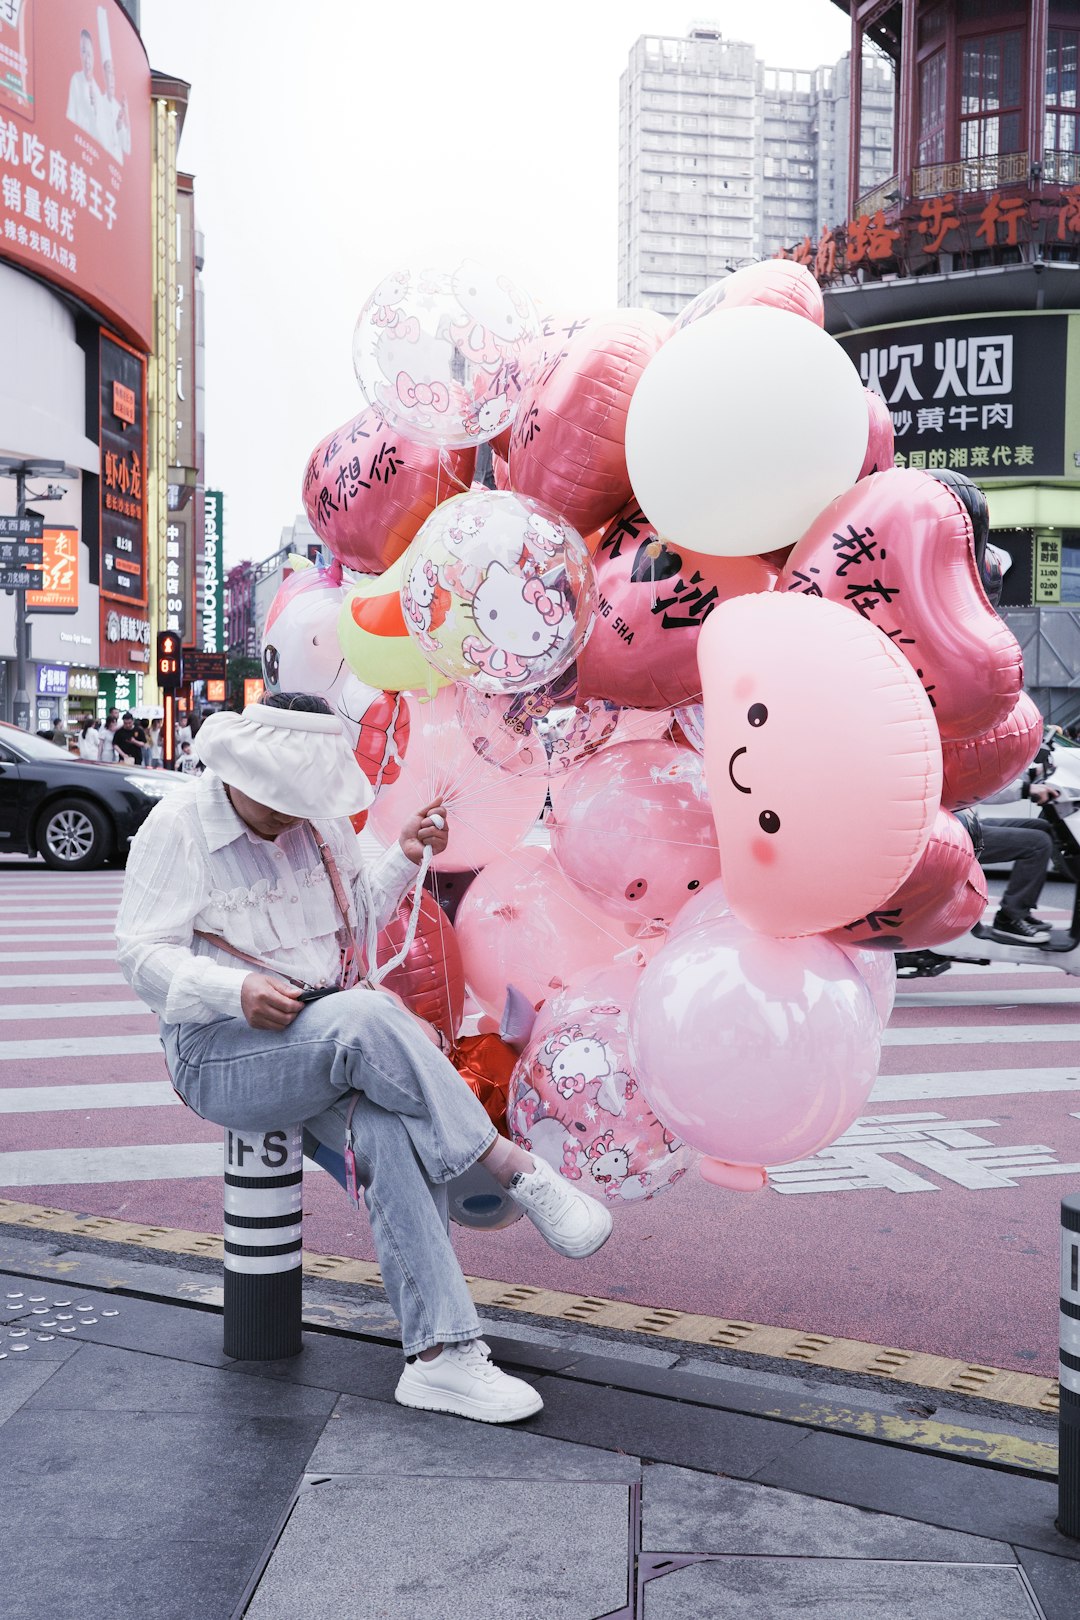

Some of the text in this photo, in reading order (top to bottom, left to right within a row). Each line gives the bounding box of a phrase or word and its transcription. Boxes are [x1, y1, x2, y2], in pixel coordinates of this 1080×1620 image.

[2, 174, 74, 242] 销量领先
[860, 334, 1013, 404] 炊烟
[312, 441, 405, 527] 很想你
[611, 616, 635, 645] SHA
[161, 659, 176, 673] 81
